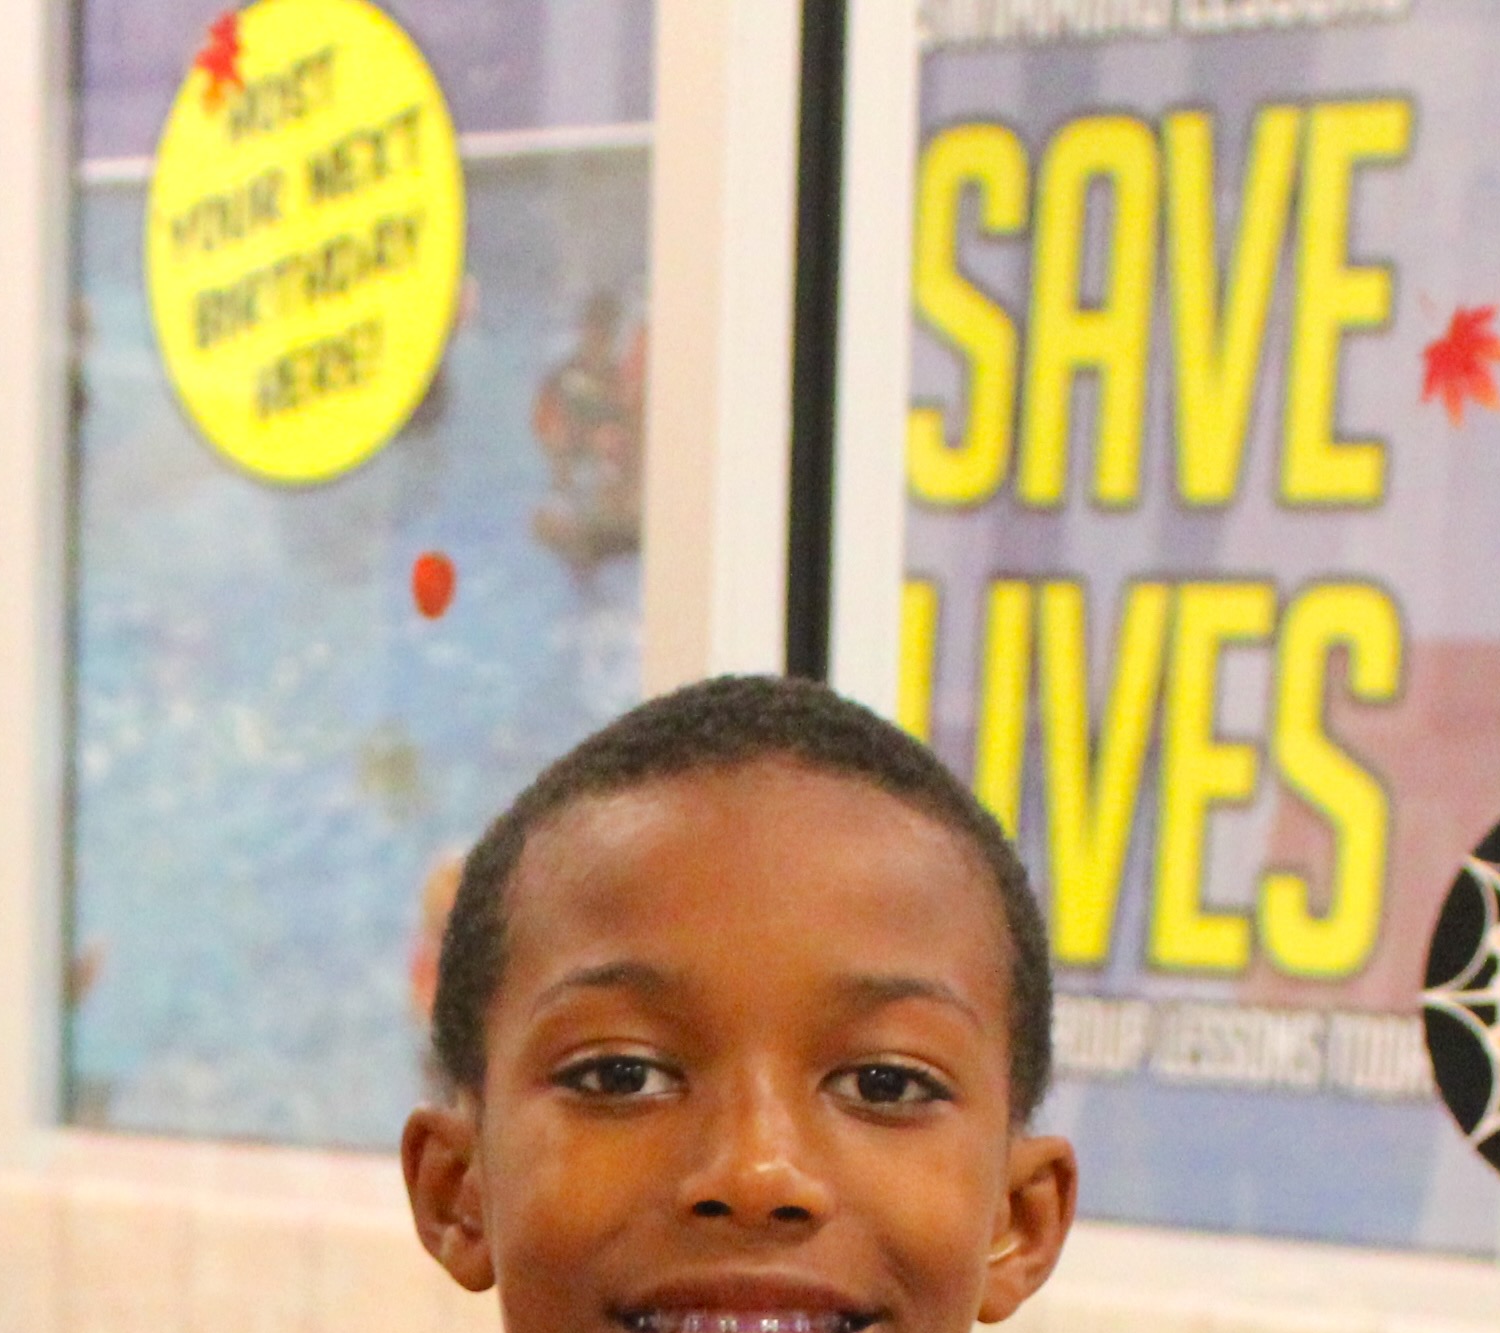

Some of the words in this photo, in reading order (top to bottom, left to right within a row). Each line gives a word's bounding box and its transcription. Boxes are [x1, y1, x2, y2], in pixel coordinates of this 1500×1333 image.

[170, 164, 286, 263] YOUR
[304, 104, 423, 203] NEXT
[905, 96, 1414, 507] SAVE
